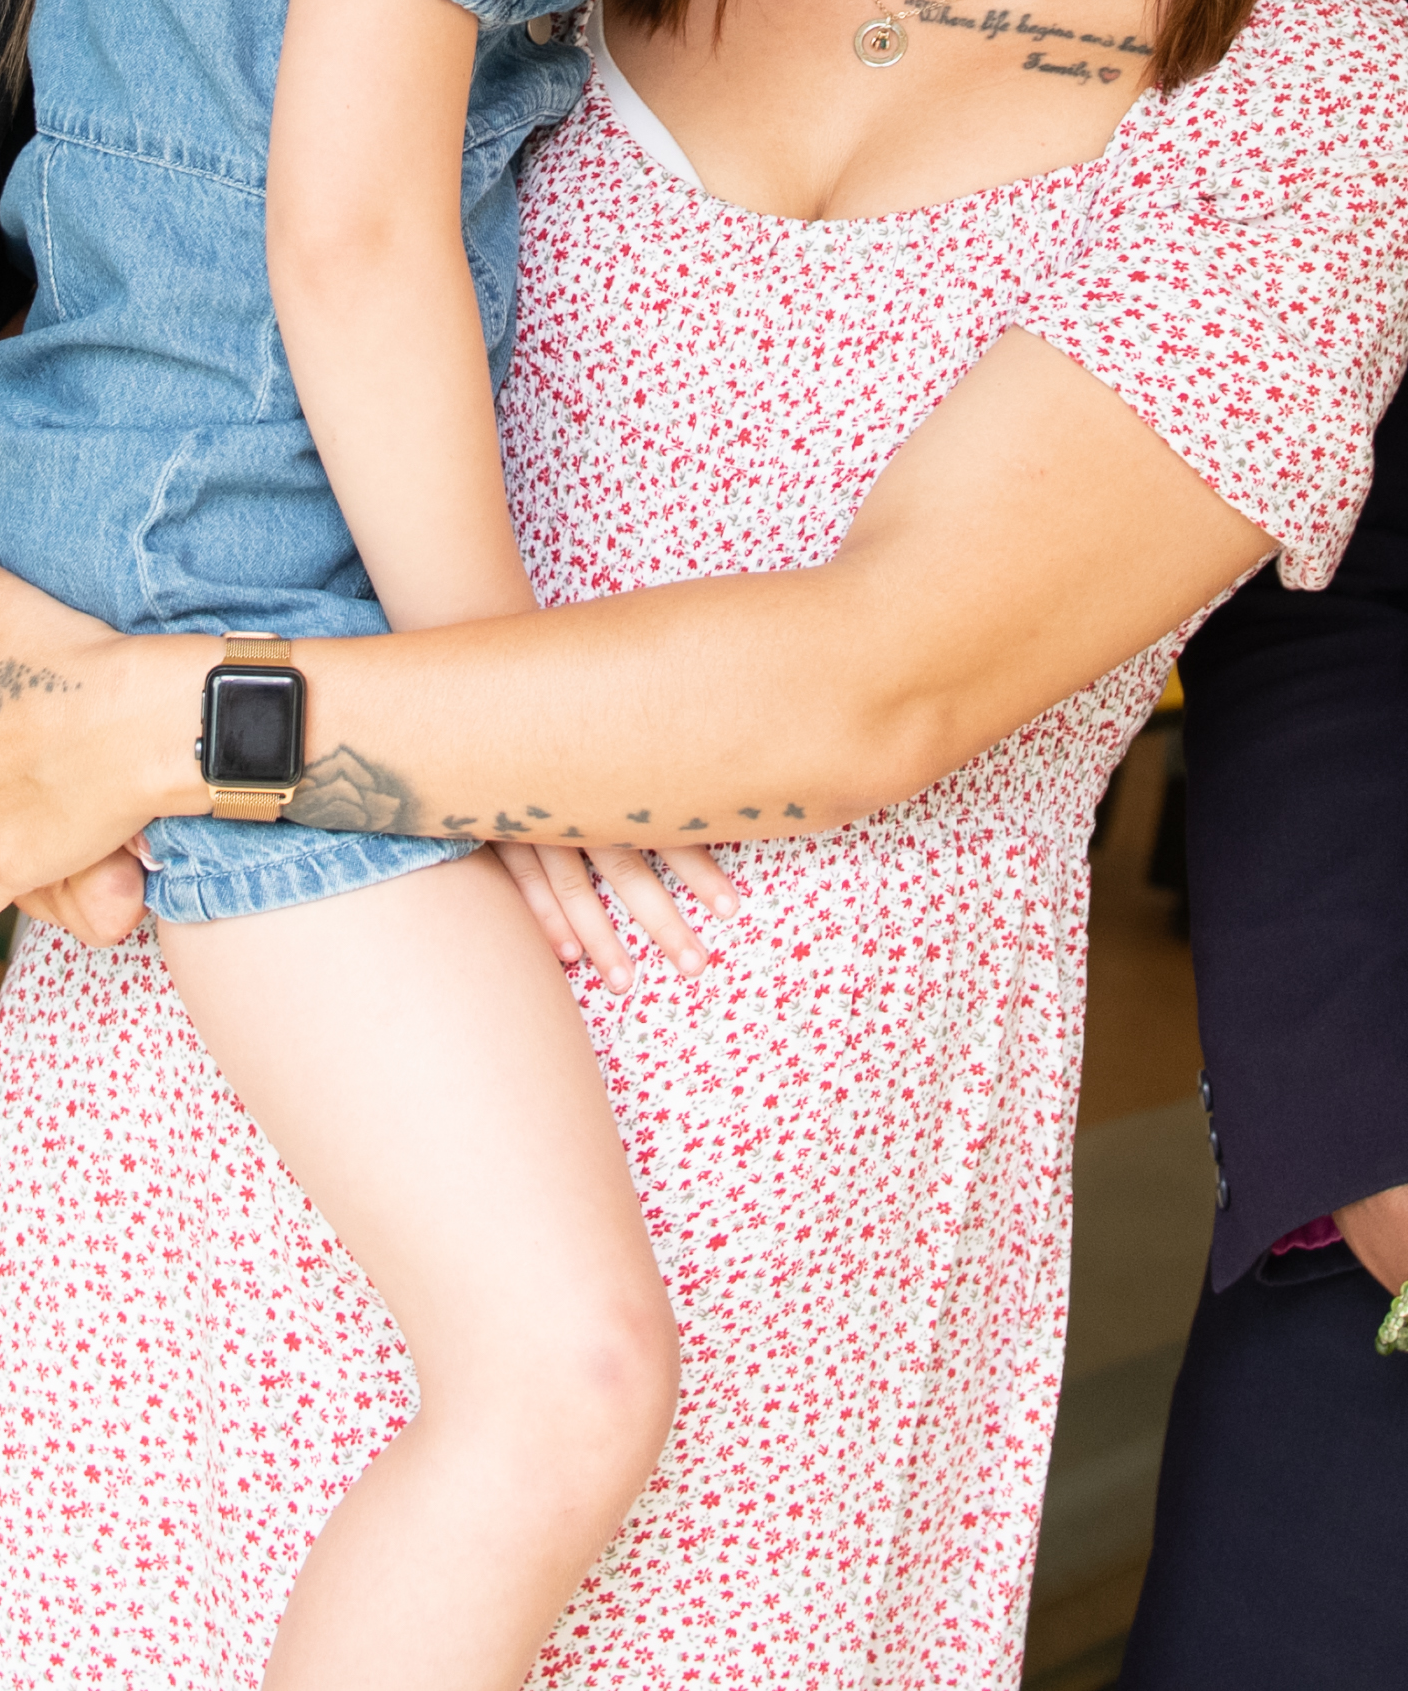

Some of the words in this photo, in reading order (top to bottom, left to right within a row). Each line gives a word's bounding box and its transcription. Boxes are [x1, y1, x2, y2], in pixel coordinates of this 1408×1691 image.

[980, 9, 1010, 40] life
[1016, 13, 1074, 41] begins
[1022, 51, 1093, 85] Family
